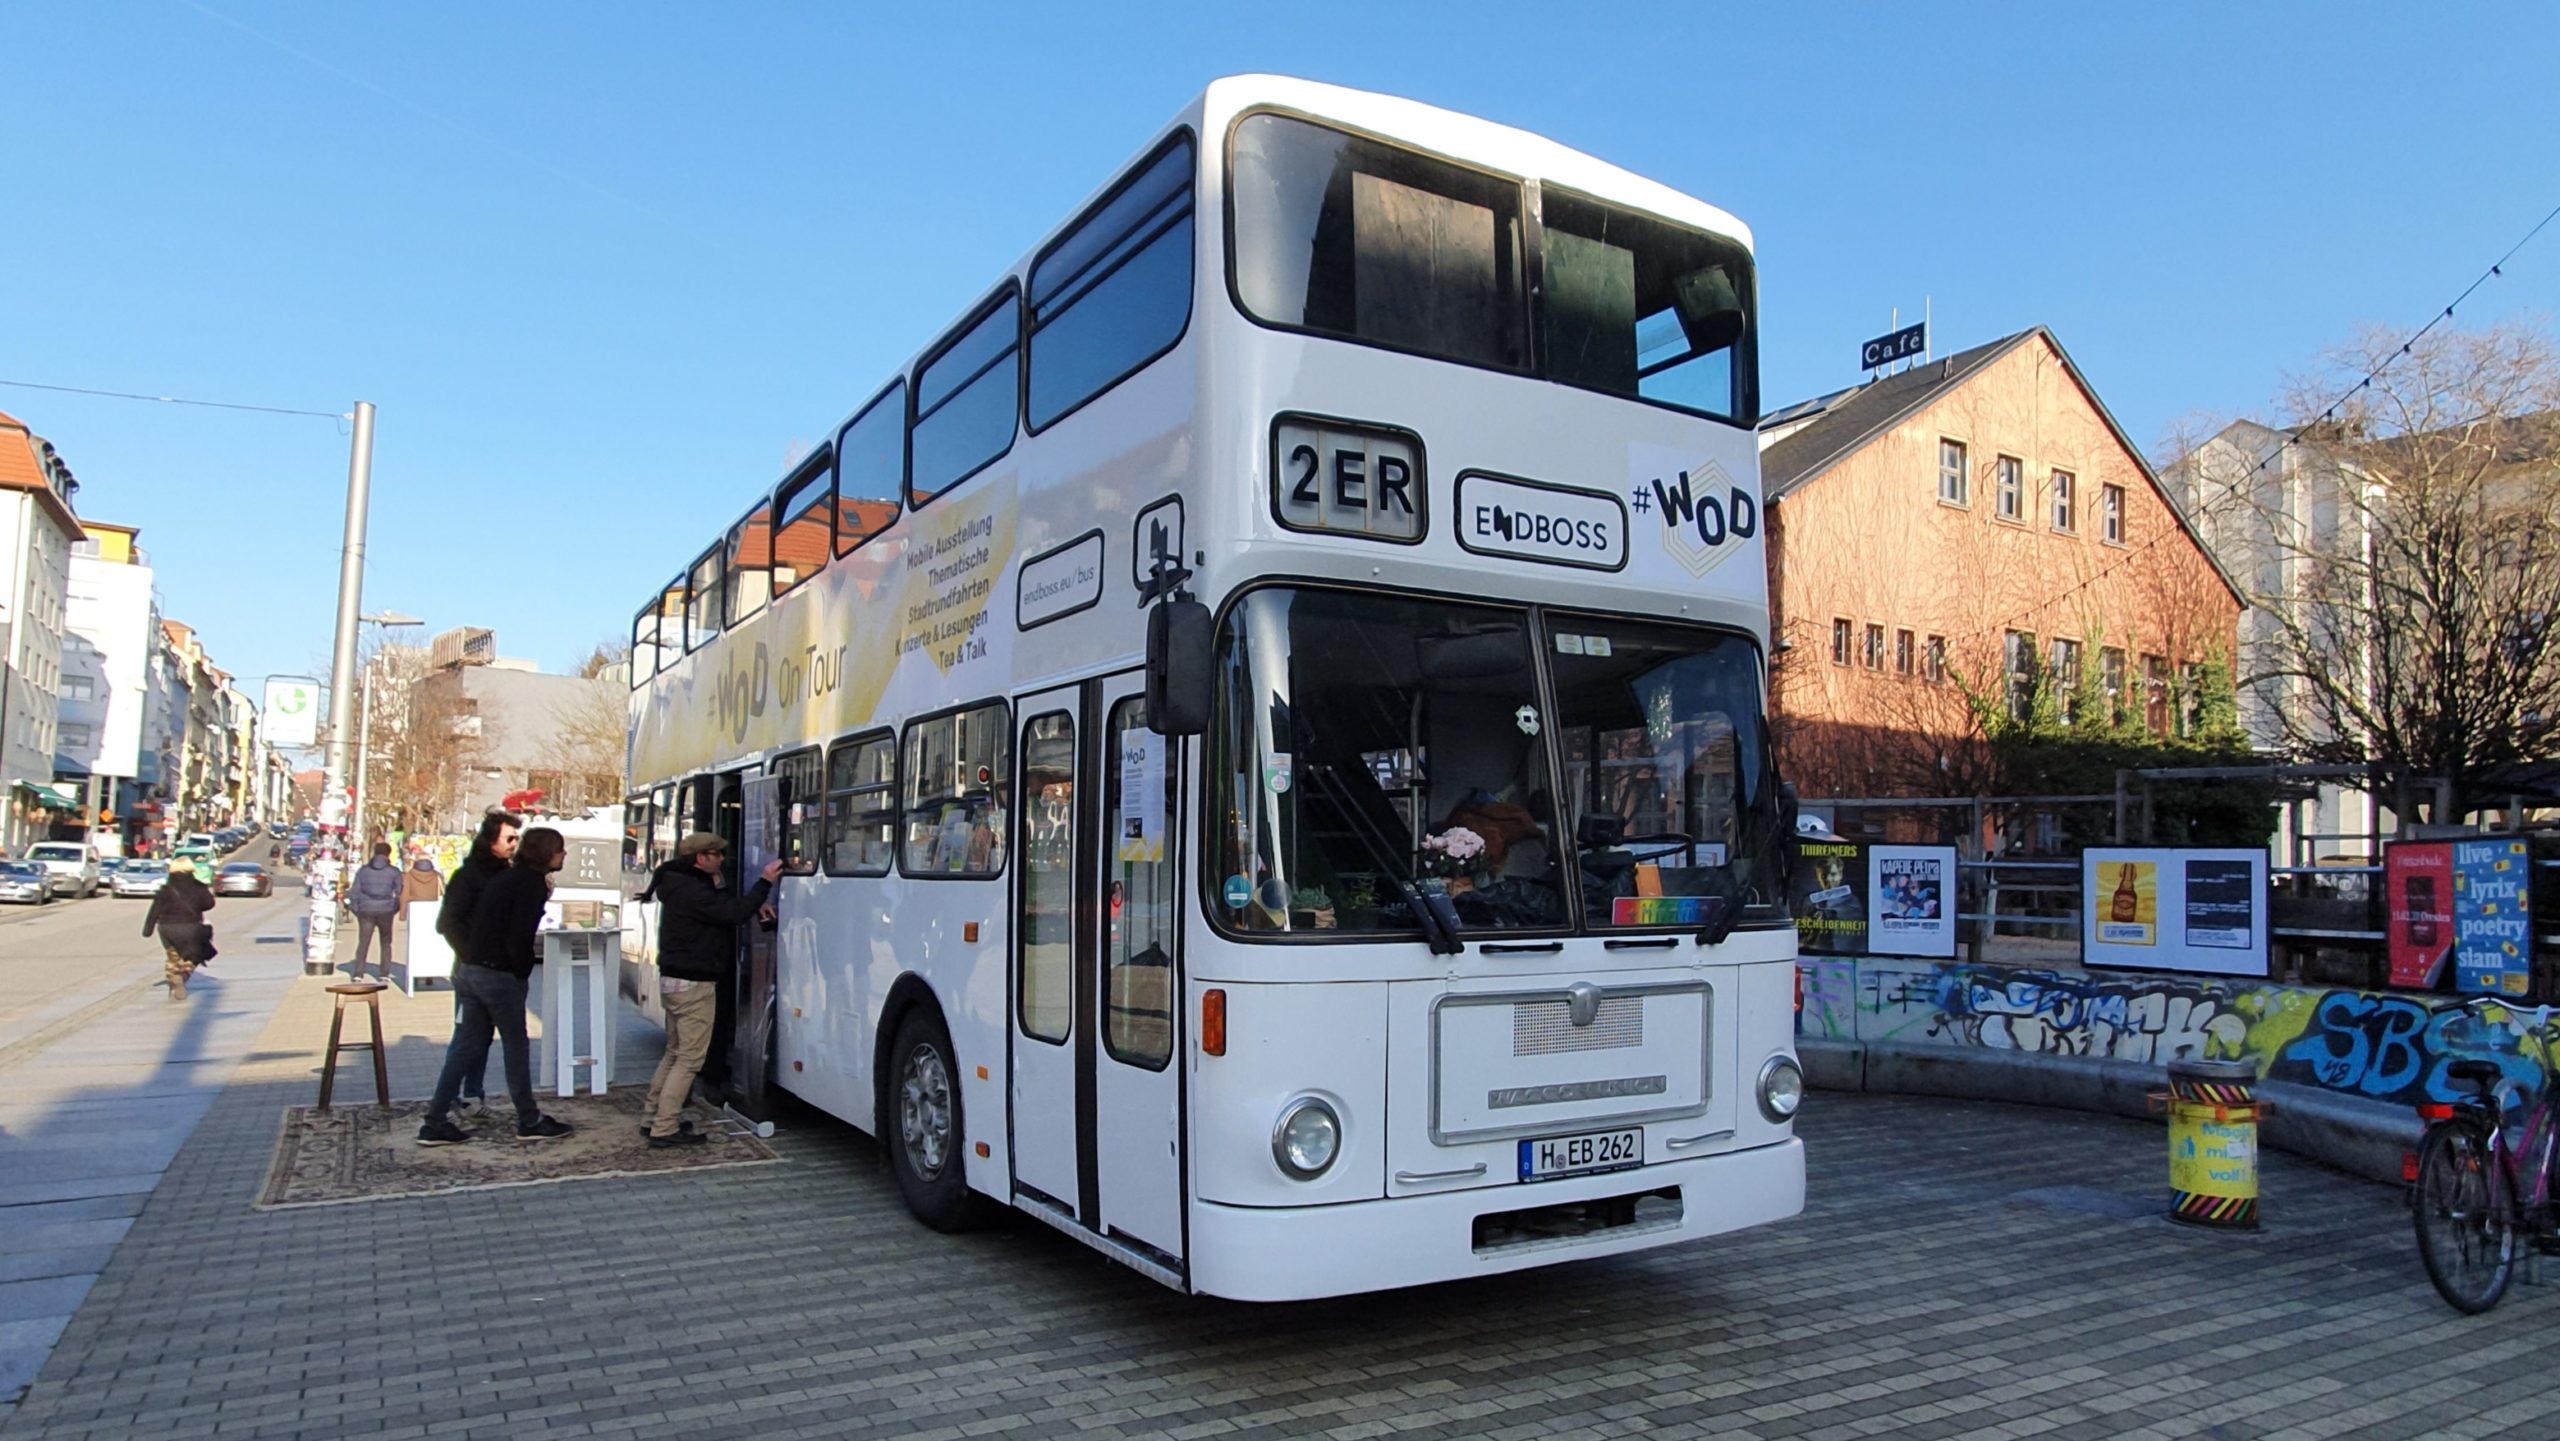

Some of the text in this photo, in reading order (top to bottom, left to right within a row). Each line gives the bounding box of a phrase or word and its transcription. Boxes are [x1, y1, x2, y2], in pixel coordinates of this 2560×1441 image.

[1865, 331, 1920, 364] Café
[1292, 444, 1414, 514] 2ER
[1632, 470, 1756, 546] #WOD
[906, 514, 993, 571] Mobile Ausstellung
[928, 547, 989, 588] Thematische
[908, 578, 990, 624] Stadtrundfahrten
[895, 609, 988, 657] Knzerte & Lesungen
[939, 638, 987, 670] Tea & Talk
[806, 644, 847, 699] Tour
[580, 858, 596, 867] LA
[2459, 844, 2493, 864] live
[2470, 876, 2517, 904] lyrix
[1795, 918, 1867, 931] ESCHEIDENHEIT
[2462, 917, 2527, 942] poetry
[2457, 946, 2504, 968] slam
[1523, 1134, 1634, 1170] D H EB 262
